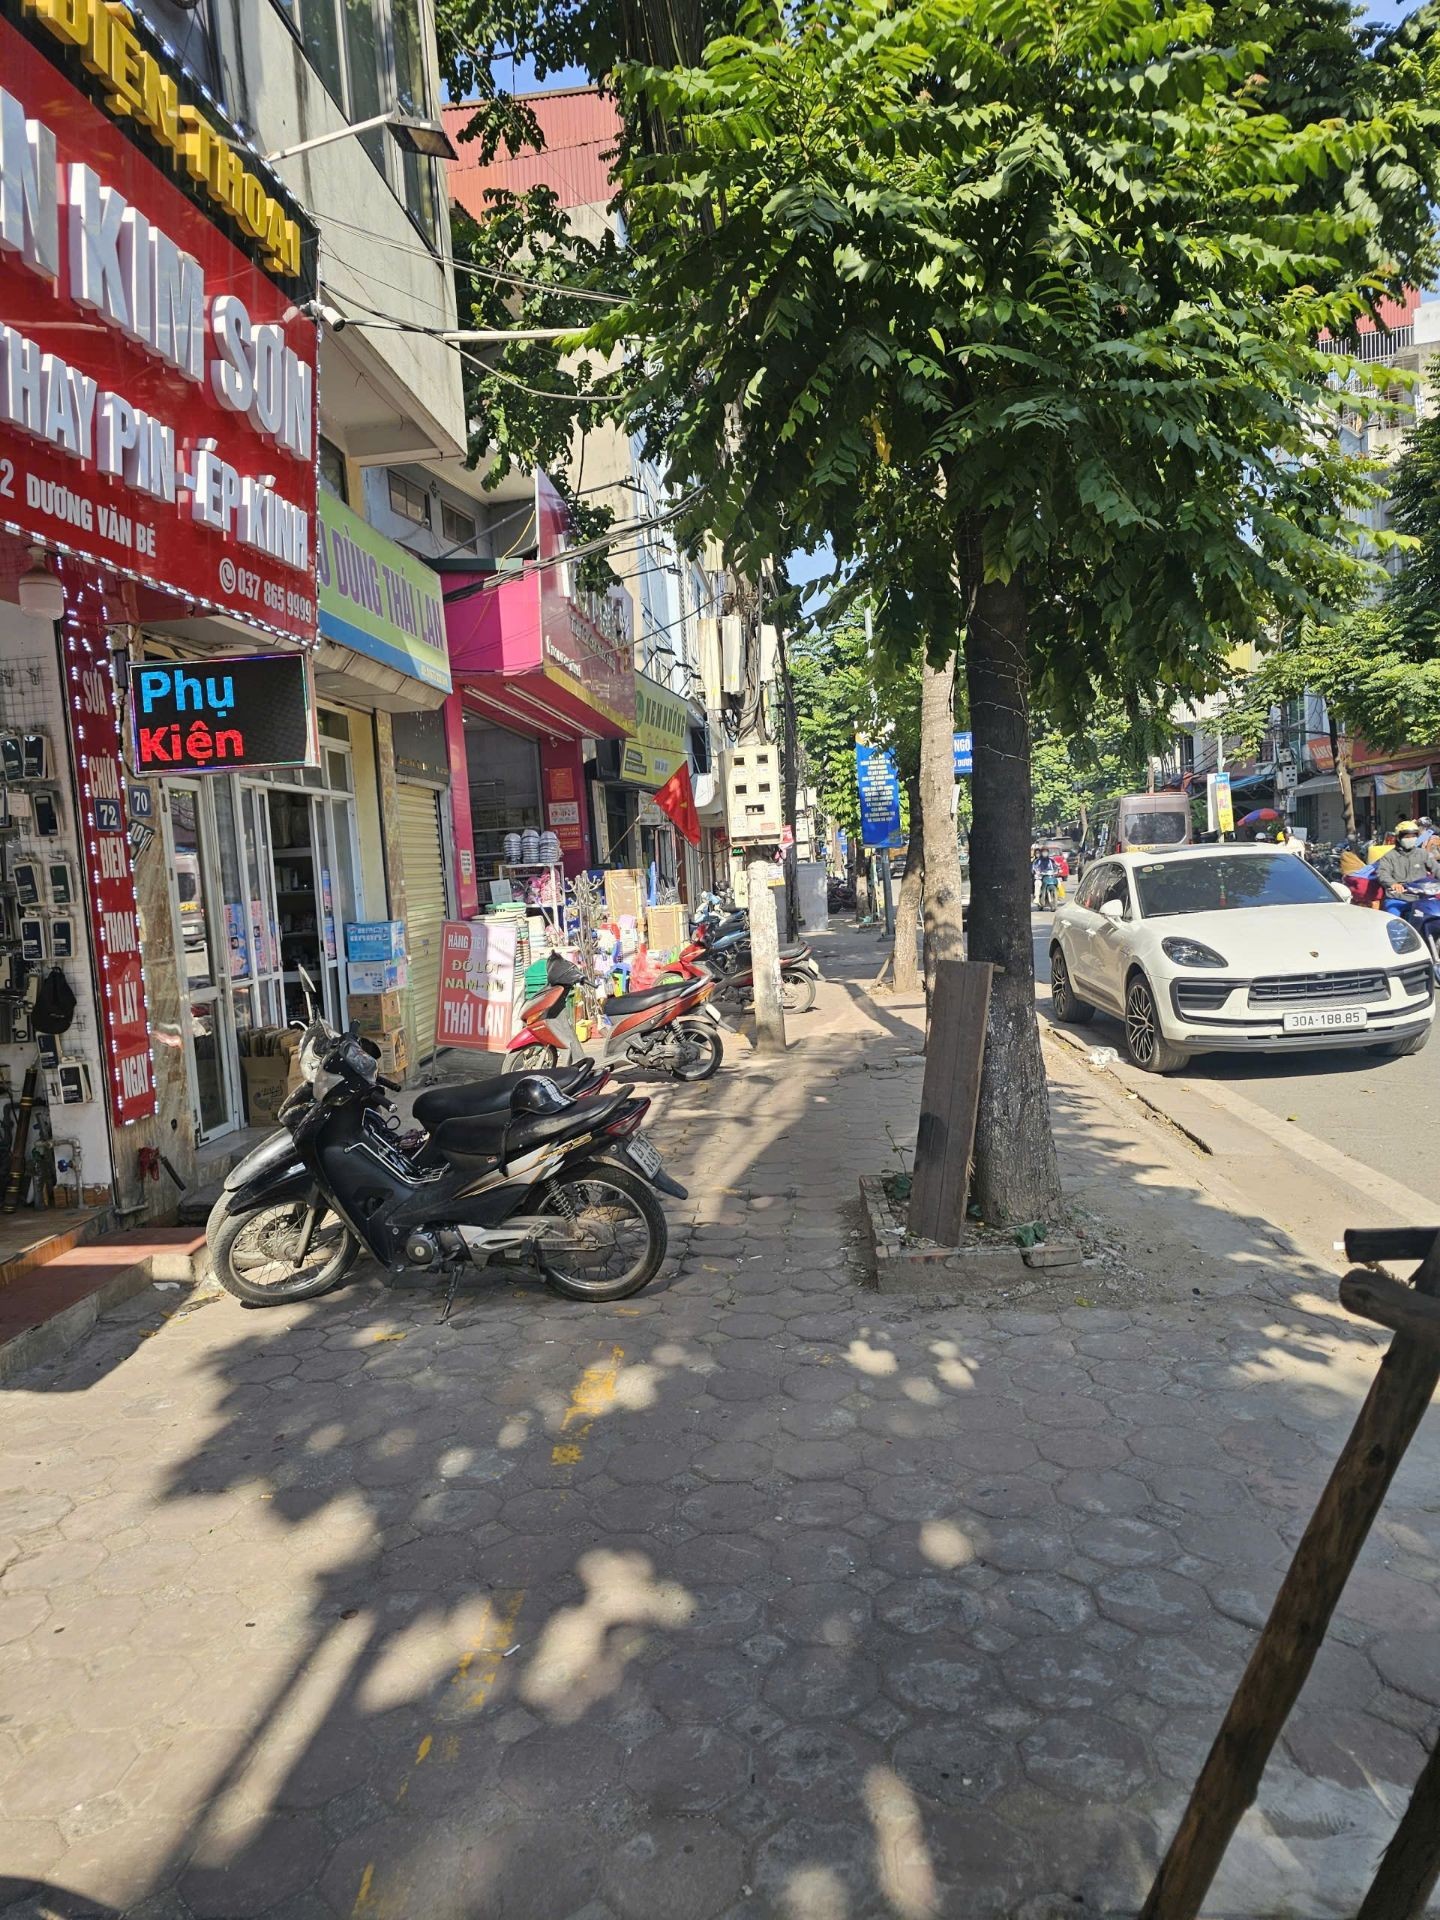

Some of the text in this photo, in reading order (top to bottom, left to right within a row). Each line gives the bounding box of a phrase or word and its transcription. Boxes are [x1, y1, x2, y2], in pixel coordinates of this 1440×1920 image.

[178, 105, 300, 277] THOẠI
[68, 162, 204, 382] KIM
[211, 296, 311, 461] SƠN
[0, 322, 97, 460] HAY
[237, 474, 308, 571] KÍNH
[26, 473, 93, 530] DƯƠNG
[97, 500, 131, 549] VĂN
[136, 520, 156, 558] BÉ
[238, 567, 312, 624] 037 865 9999
[332, 524, 384, 618] DÙNG
[382, 565, 418, 636] THÁI
[417, 588, 443, 651] LAN
[141, 669, 235, 717] Phụ
[139, 720, 243, 765] Kiện
[89, 748, 121, 799] CHỮA
[101, 806, 117, 825] 72
[133, 791, 148, 812] 70
[99, 831, 127, 886] ĐIỆN
[102, 911, 136, 959] THOẠI
[447, 931, 469, 948] HÀNG
[451, 958, 474, 973] ĐỒ
[443, 994, 505, 1038] THÁI LAN
[1291, 1012, 1360, 1027] 30A-188.85
[121, 1052, 149, 1100] NGAY
